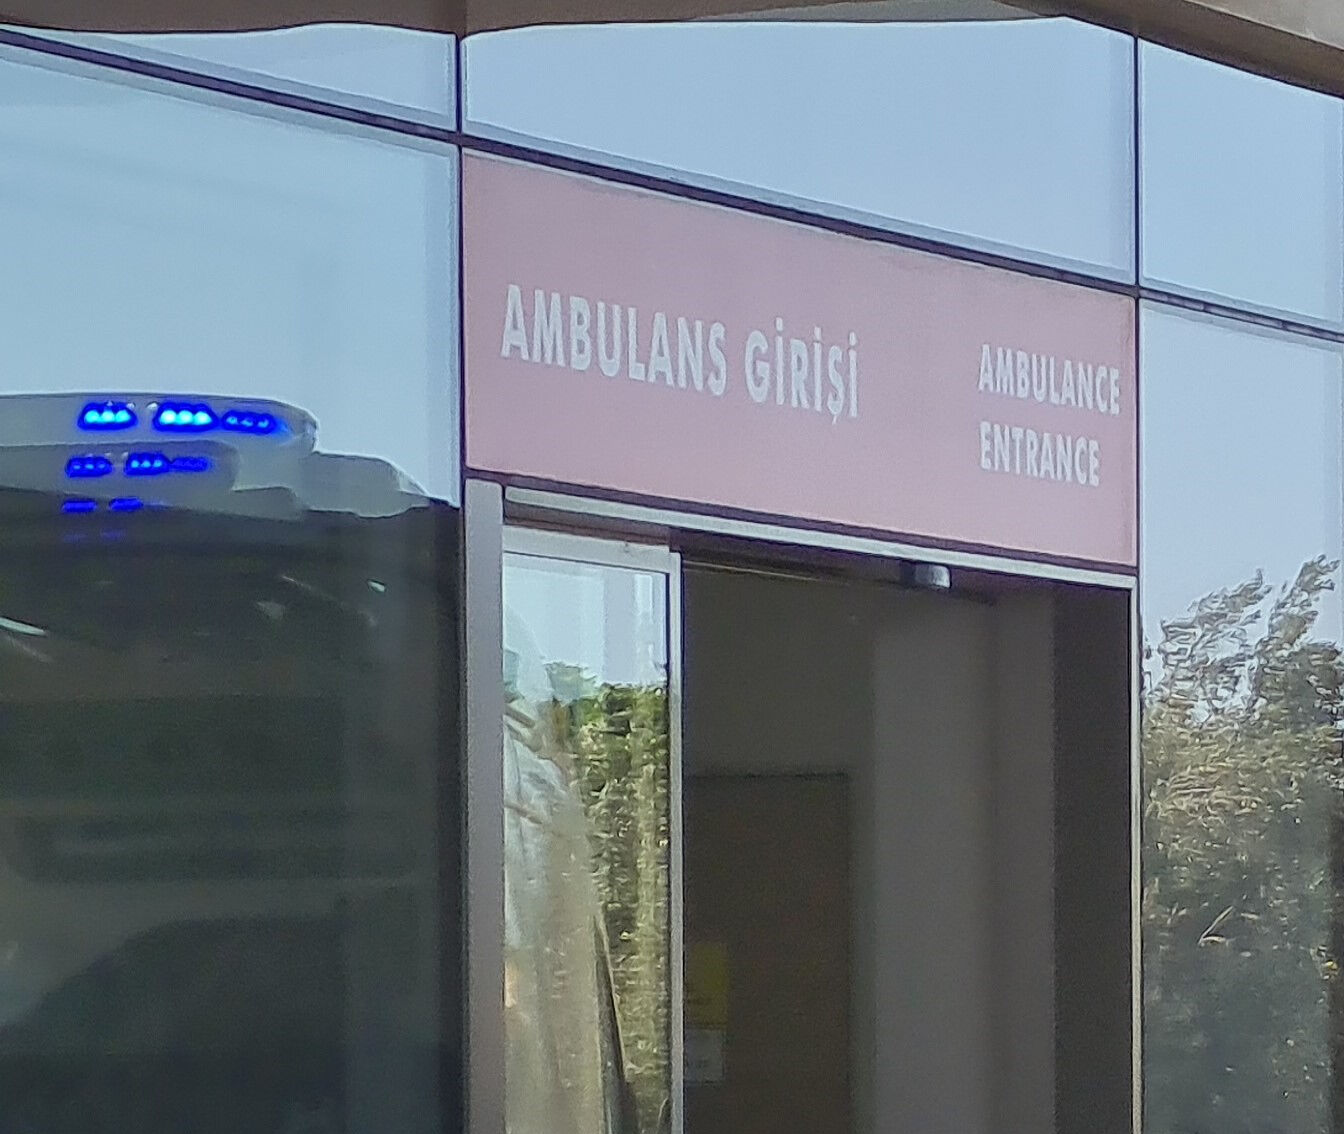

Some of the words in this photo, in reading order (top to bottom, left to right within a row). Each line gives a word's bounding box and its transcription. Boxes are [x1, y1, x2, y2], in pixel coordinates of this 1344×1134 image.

[500, 283, 728, 397] AMBULANS
[743, 315, 859, 425] GİRİŞİ
[977, 342, 1121, 417] AMBULANCE
[979, 419, 1100, 487] ENTRANCE
